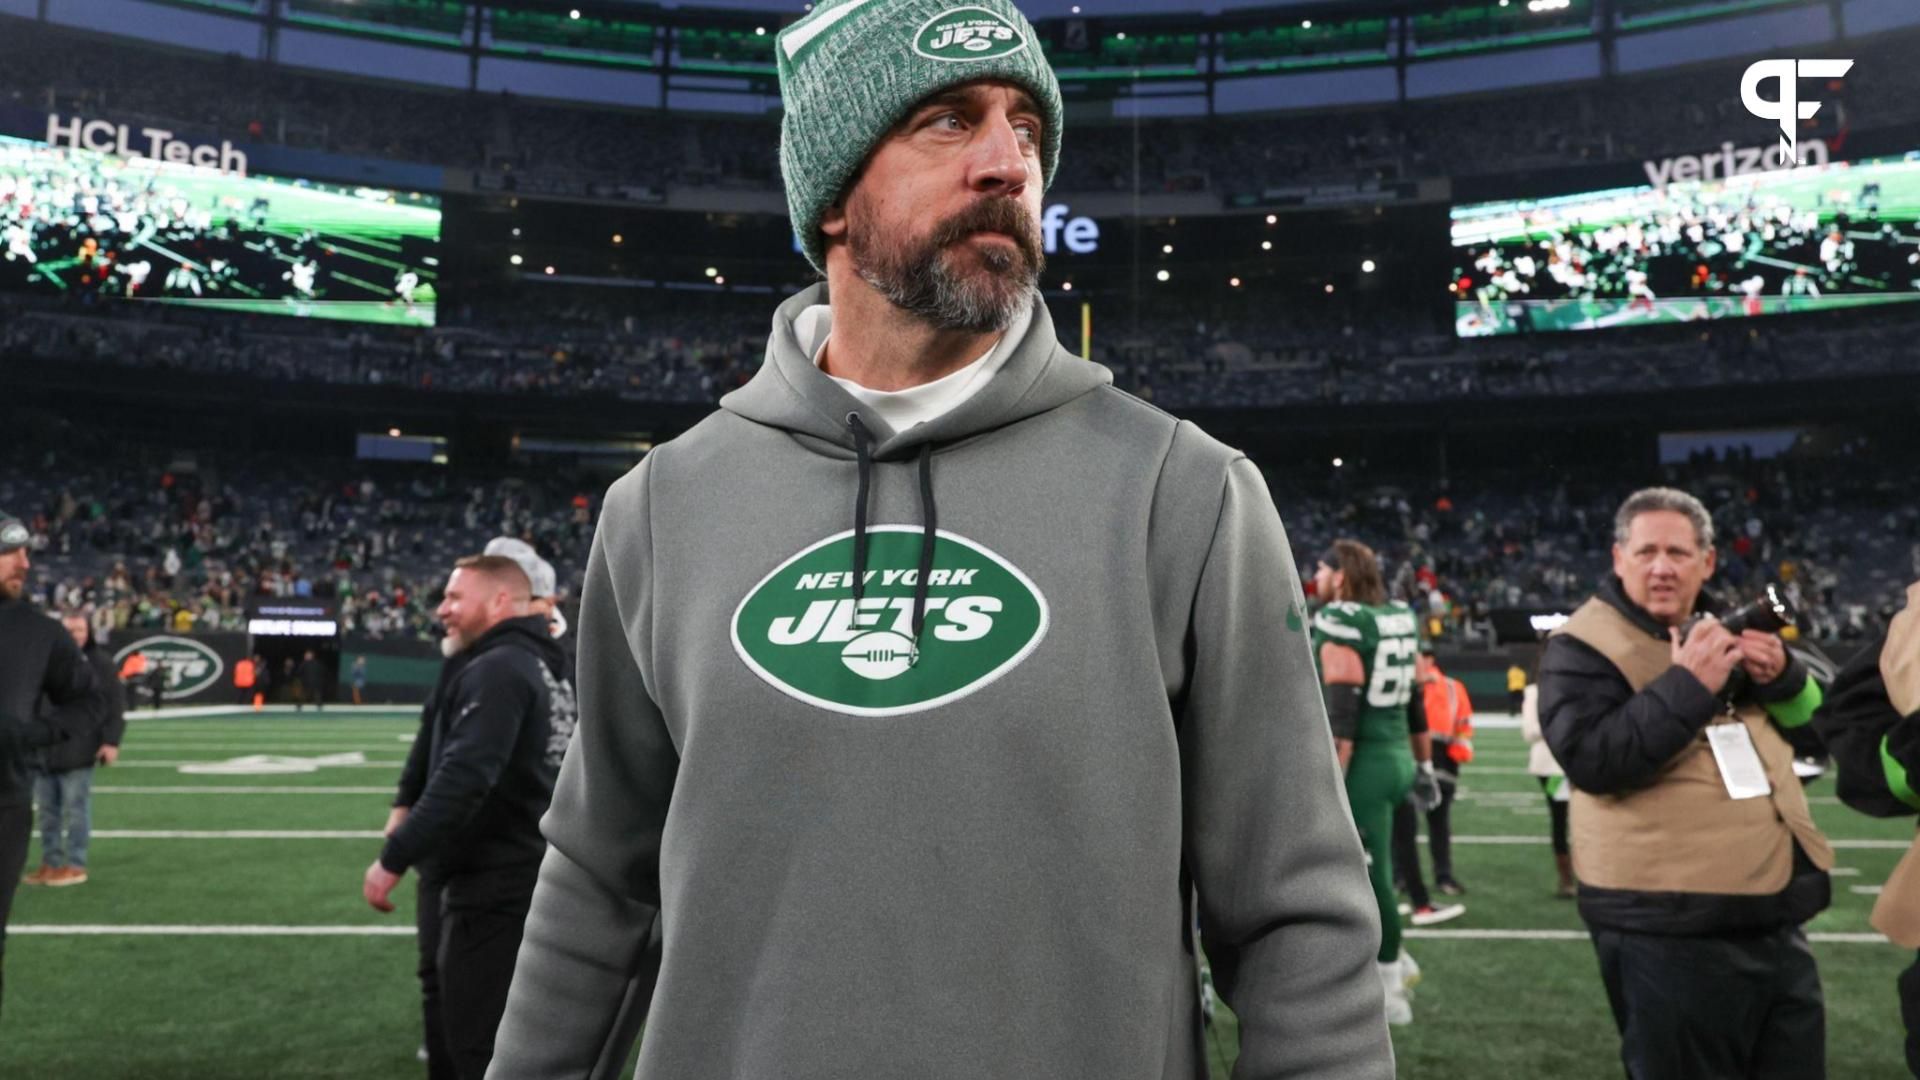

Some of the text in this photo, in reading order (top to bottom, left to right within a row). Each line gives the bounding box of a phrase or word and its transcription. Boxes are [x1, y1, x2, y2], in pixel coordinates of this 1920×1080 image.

[929, 26, 1014, 50] JETS
[935, 19, 1000, 32] NEW YORK
[46, 113, 248, 178] HCLTech
[1643, 138, 1829, 190] verizon
[794, 568, 980, 591] NEW YORK
[767, 595, 1004, 646] JETS
